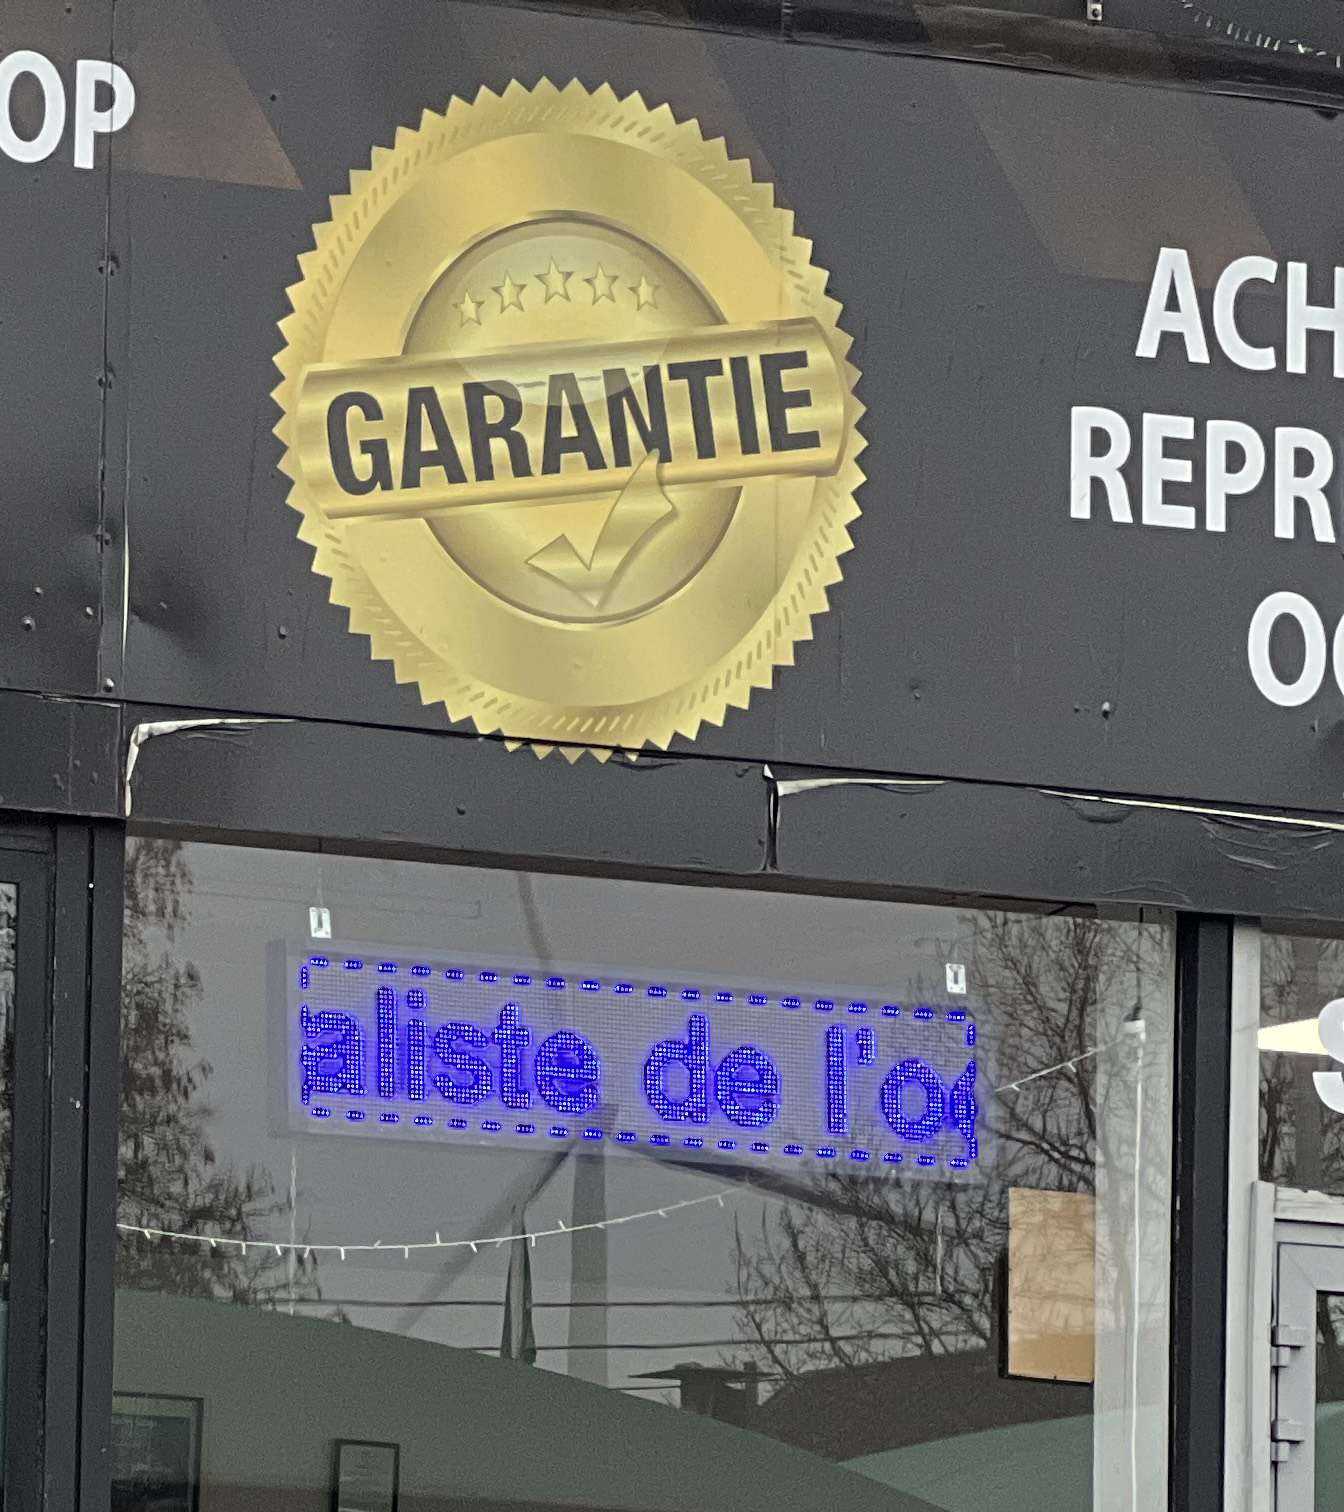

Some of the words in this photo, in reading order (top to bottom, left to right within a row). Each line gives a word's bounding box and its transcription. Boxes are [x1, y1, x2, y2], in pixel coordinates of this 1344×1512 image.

[325, 350, 822, 497] GARANTIE
[1069, 405, 1336, 544] REPR
[301, 984, 603, 1115] aliste
[642, 1012, 783, 1129] de
